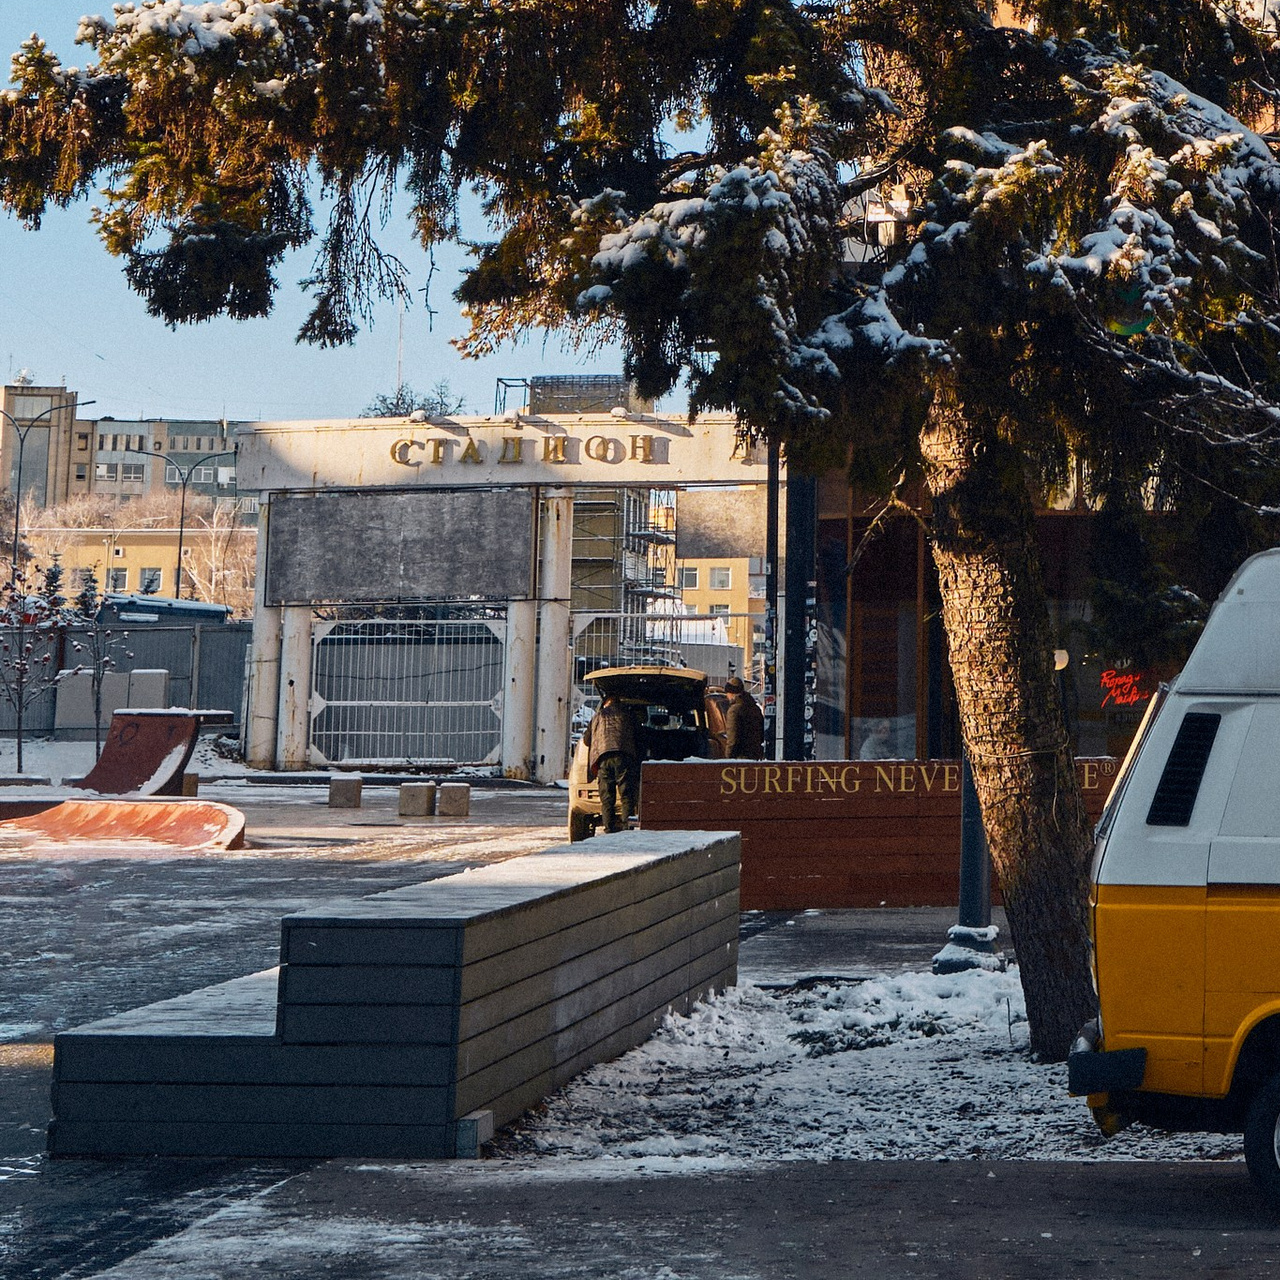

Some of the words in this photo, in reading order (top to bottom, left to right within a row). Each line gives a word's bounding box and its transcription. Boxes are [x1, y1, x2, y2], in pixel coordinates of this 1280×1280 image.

[389, 433, 653, 466] СТАДИОН
[720, 765, 861, 795] SURFING
[874, 765, 960, 794] NEVE
